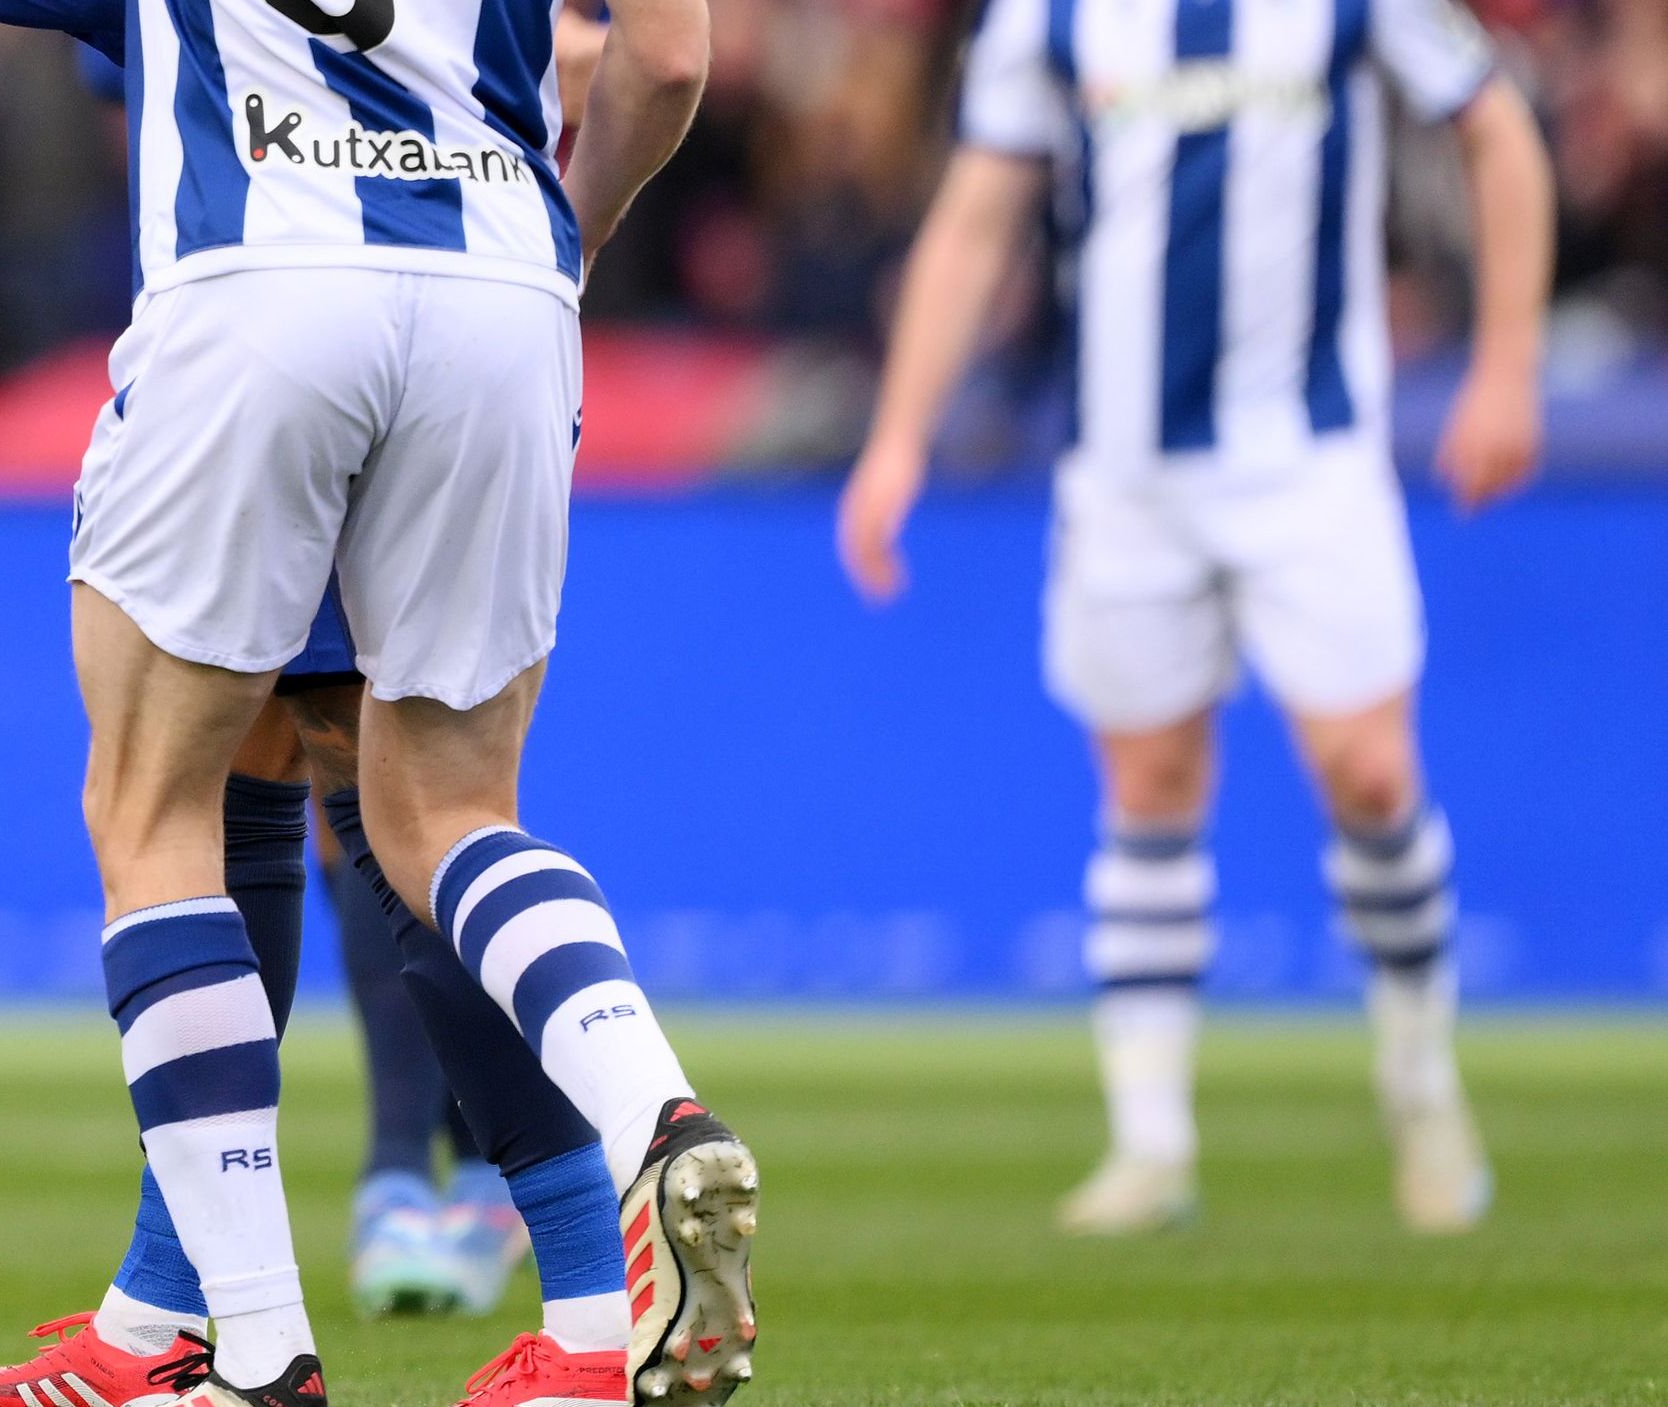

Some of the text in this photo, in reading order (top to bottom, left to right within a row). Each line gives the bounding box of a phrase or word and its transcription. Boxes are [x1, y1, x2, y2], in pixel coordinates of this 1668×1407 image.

[579, 1003, 637, 1033] RS
[220, 1147, 273, 1173] RS
[577, 1365, 626, 1374] PREDATO
